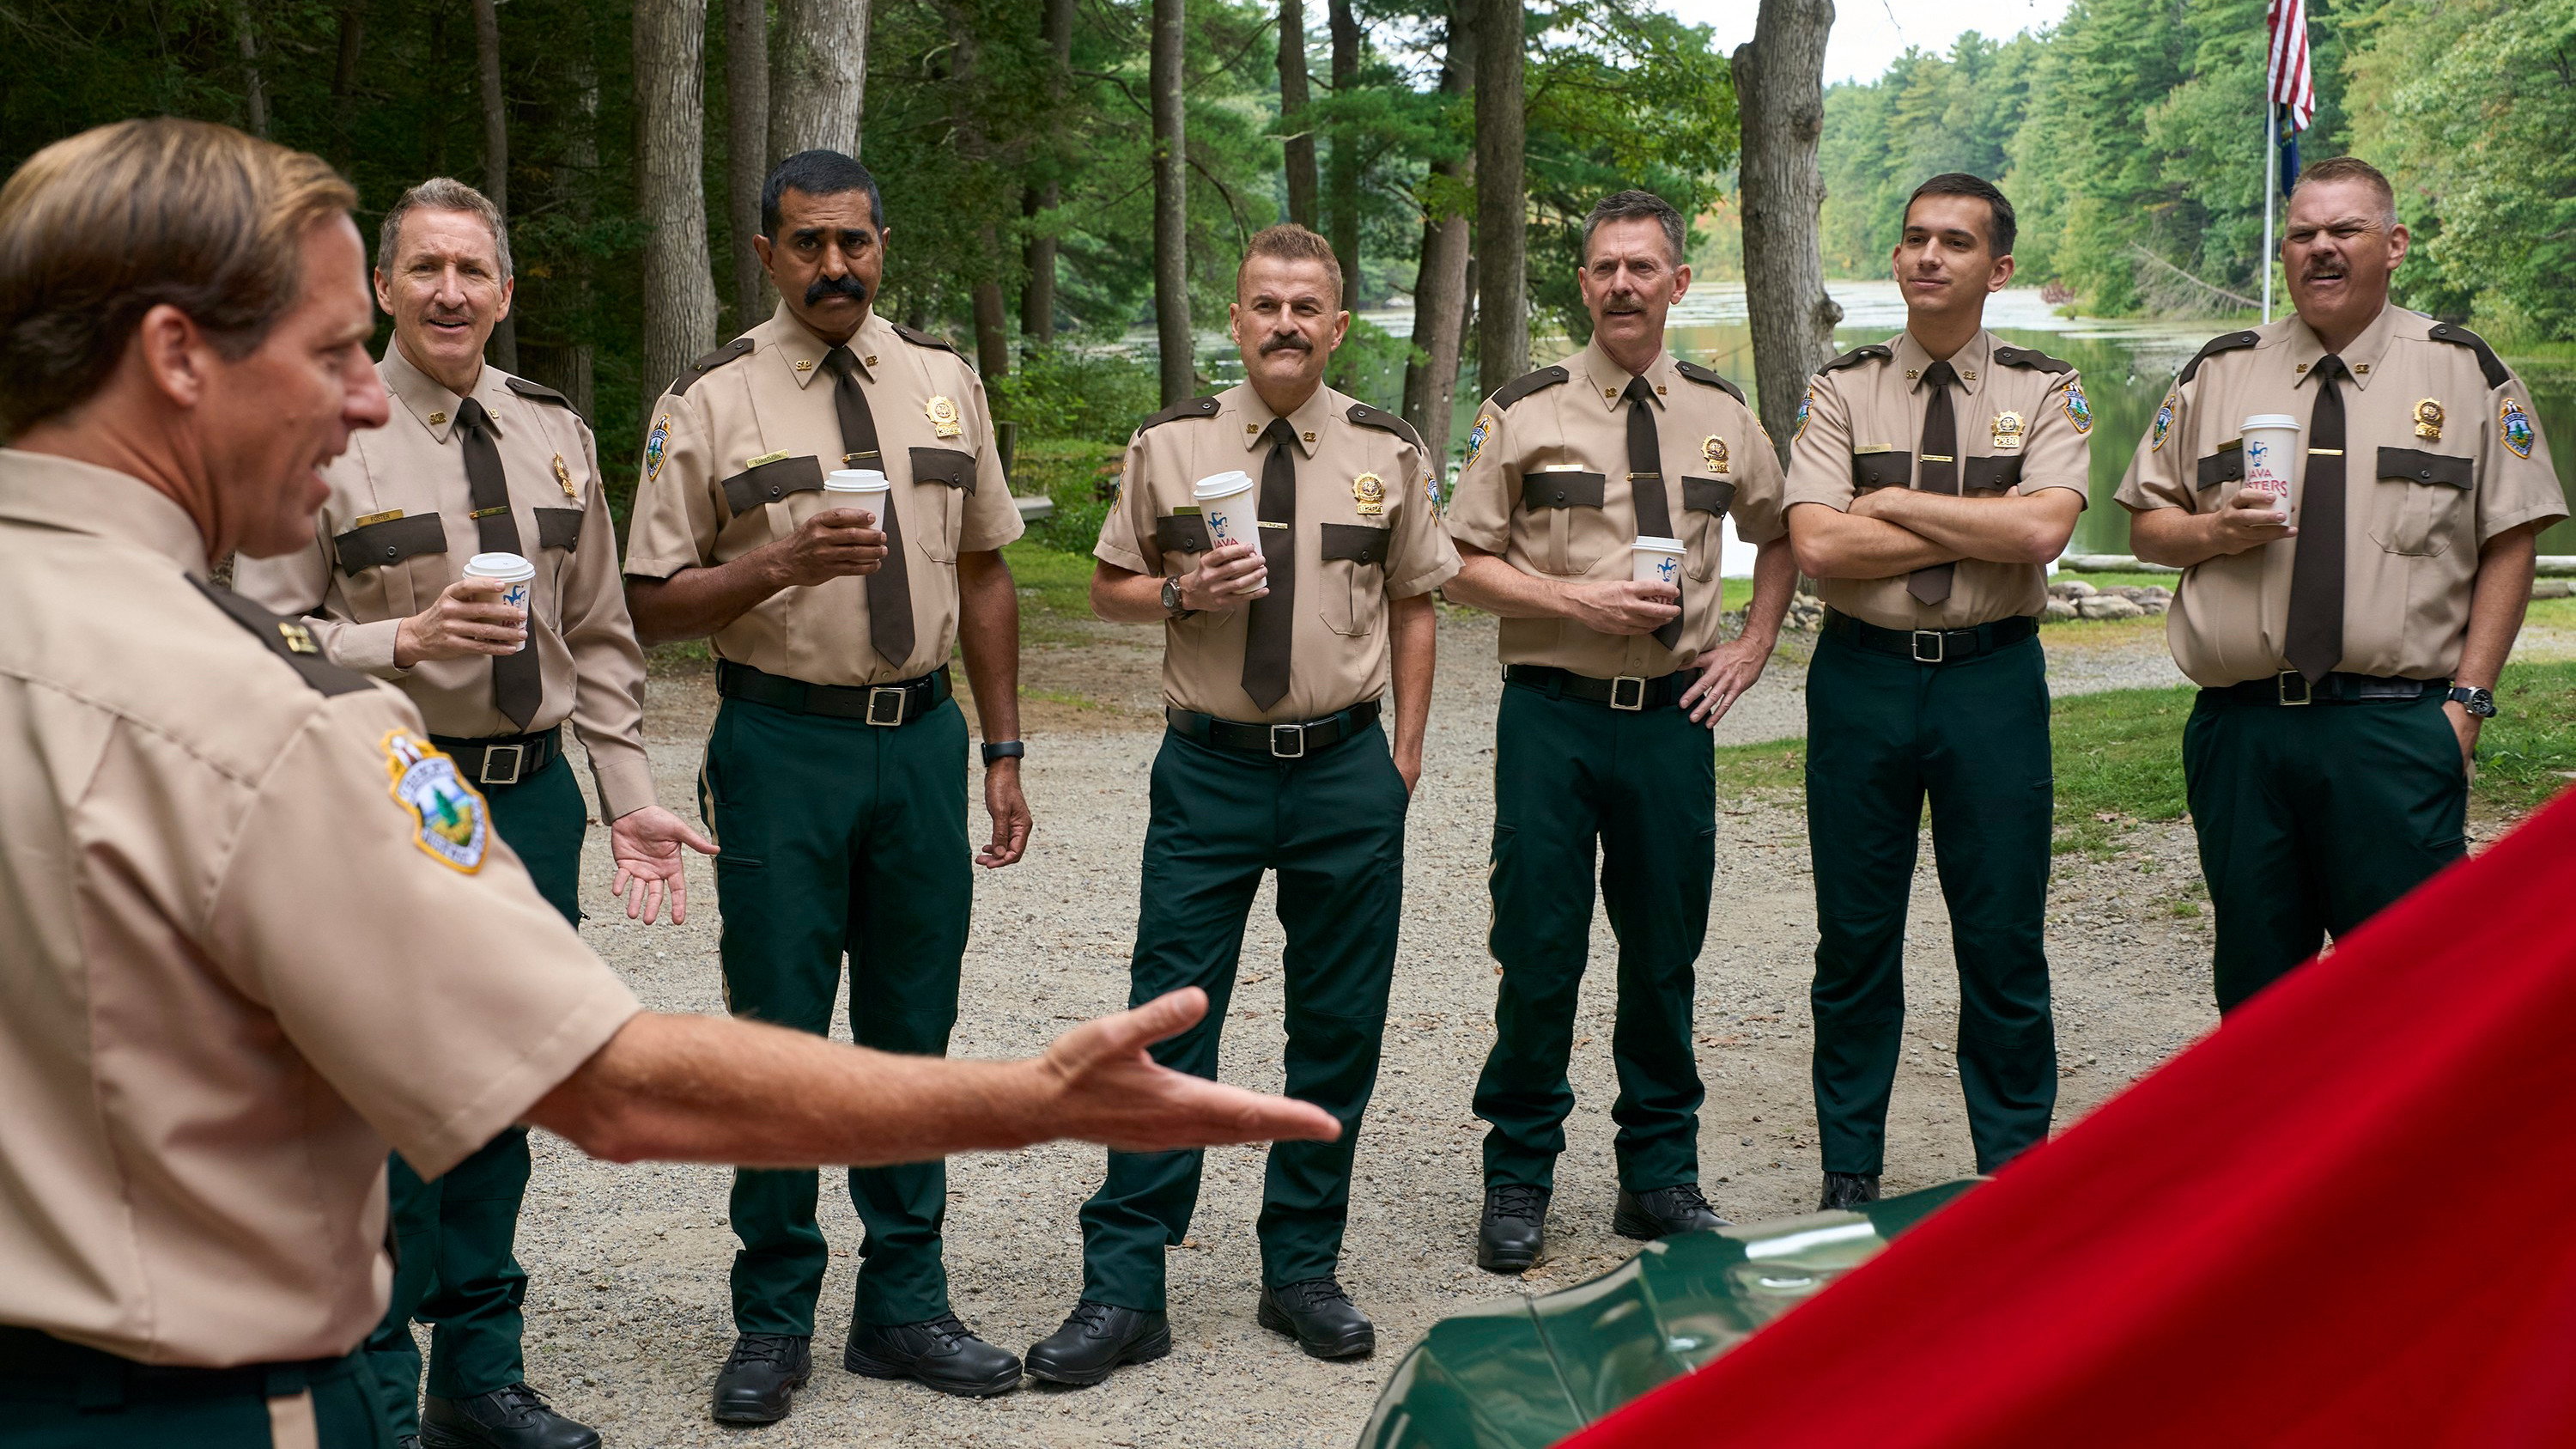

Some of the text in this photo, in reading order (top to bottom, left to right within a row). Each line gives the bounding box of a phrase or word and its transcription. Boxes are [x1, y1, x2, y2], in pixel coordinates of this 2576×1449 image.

[2245, 479, 2287, 498] STERS
[370, 513, 390, 522] FOSTER
[1212, 537, 1239, 549] JAVA
